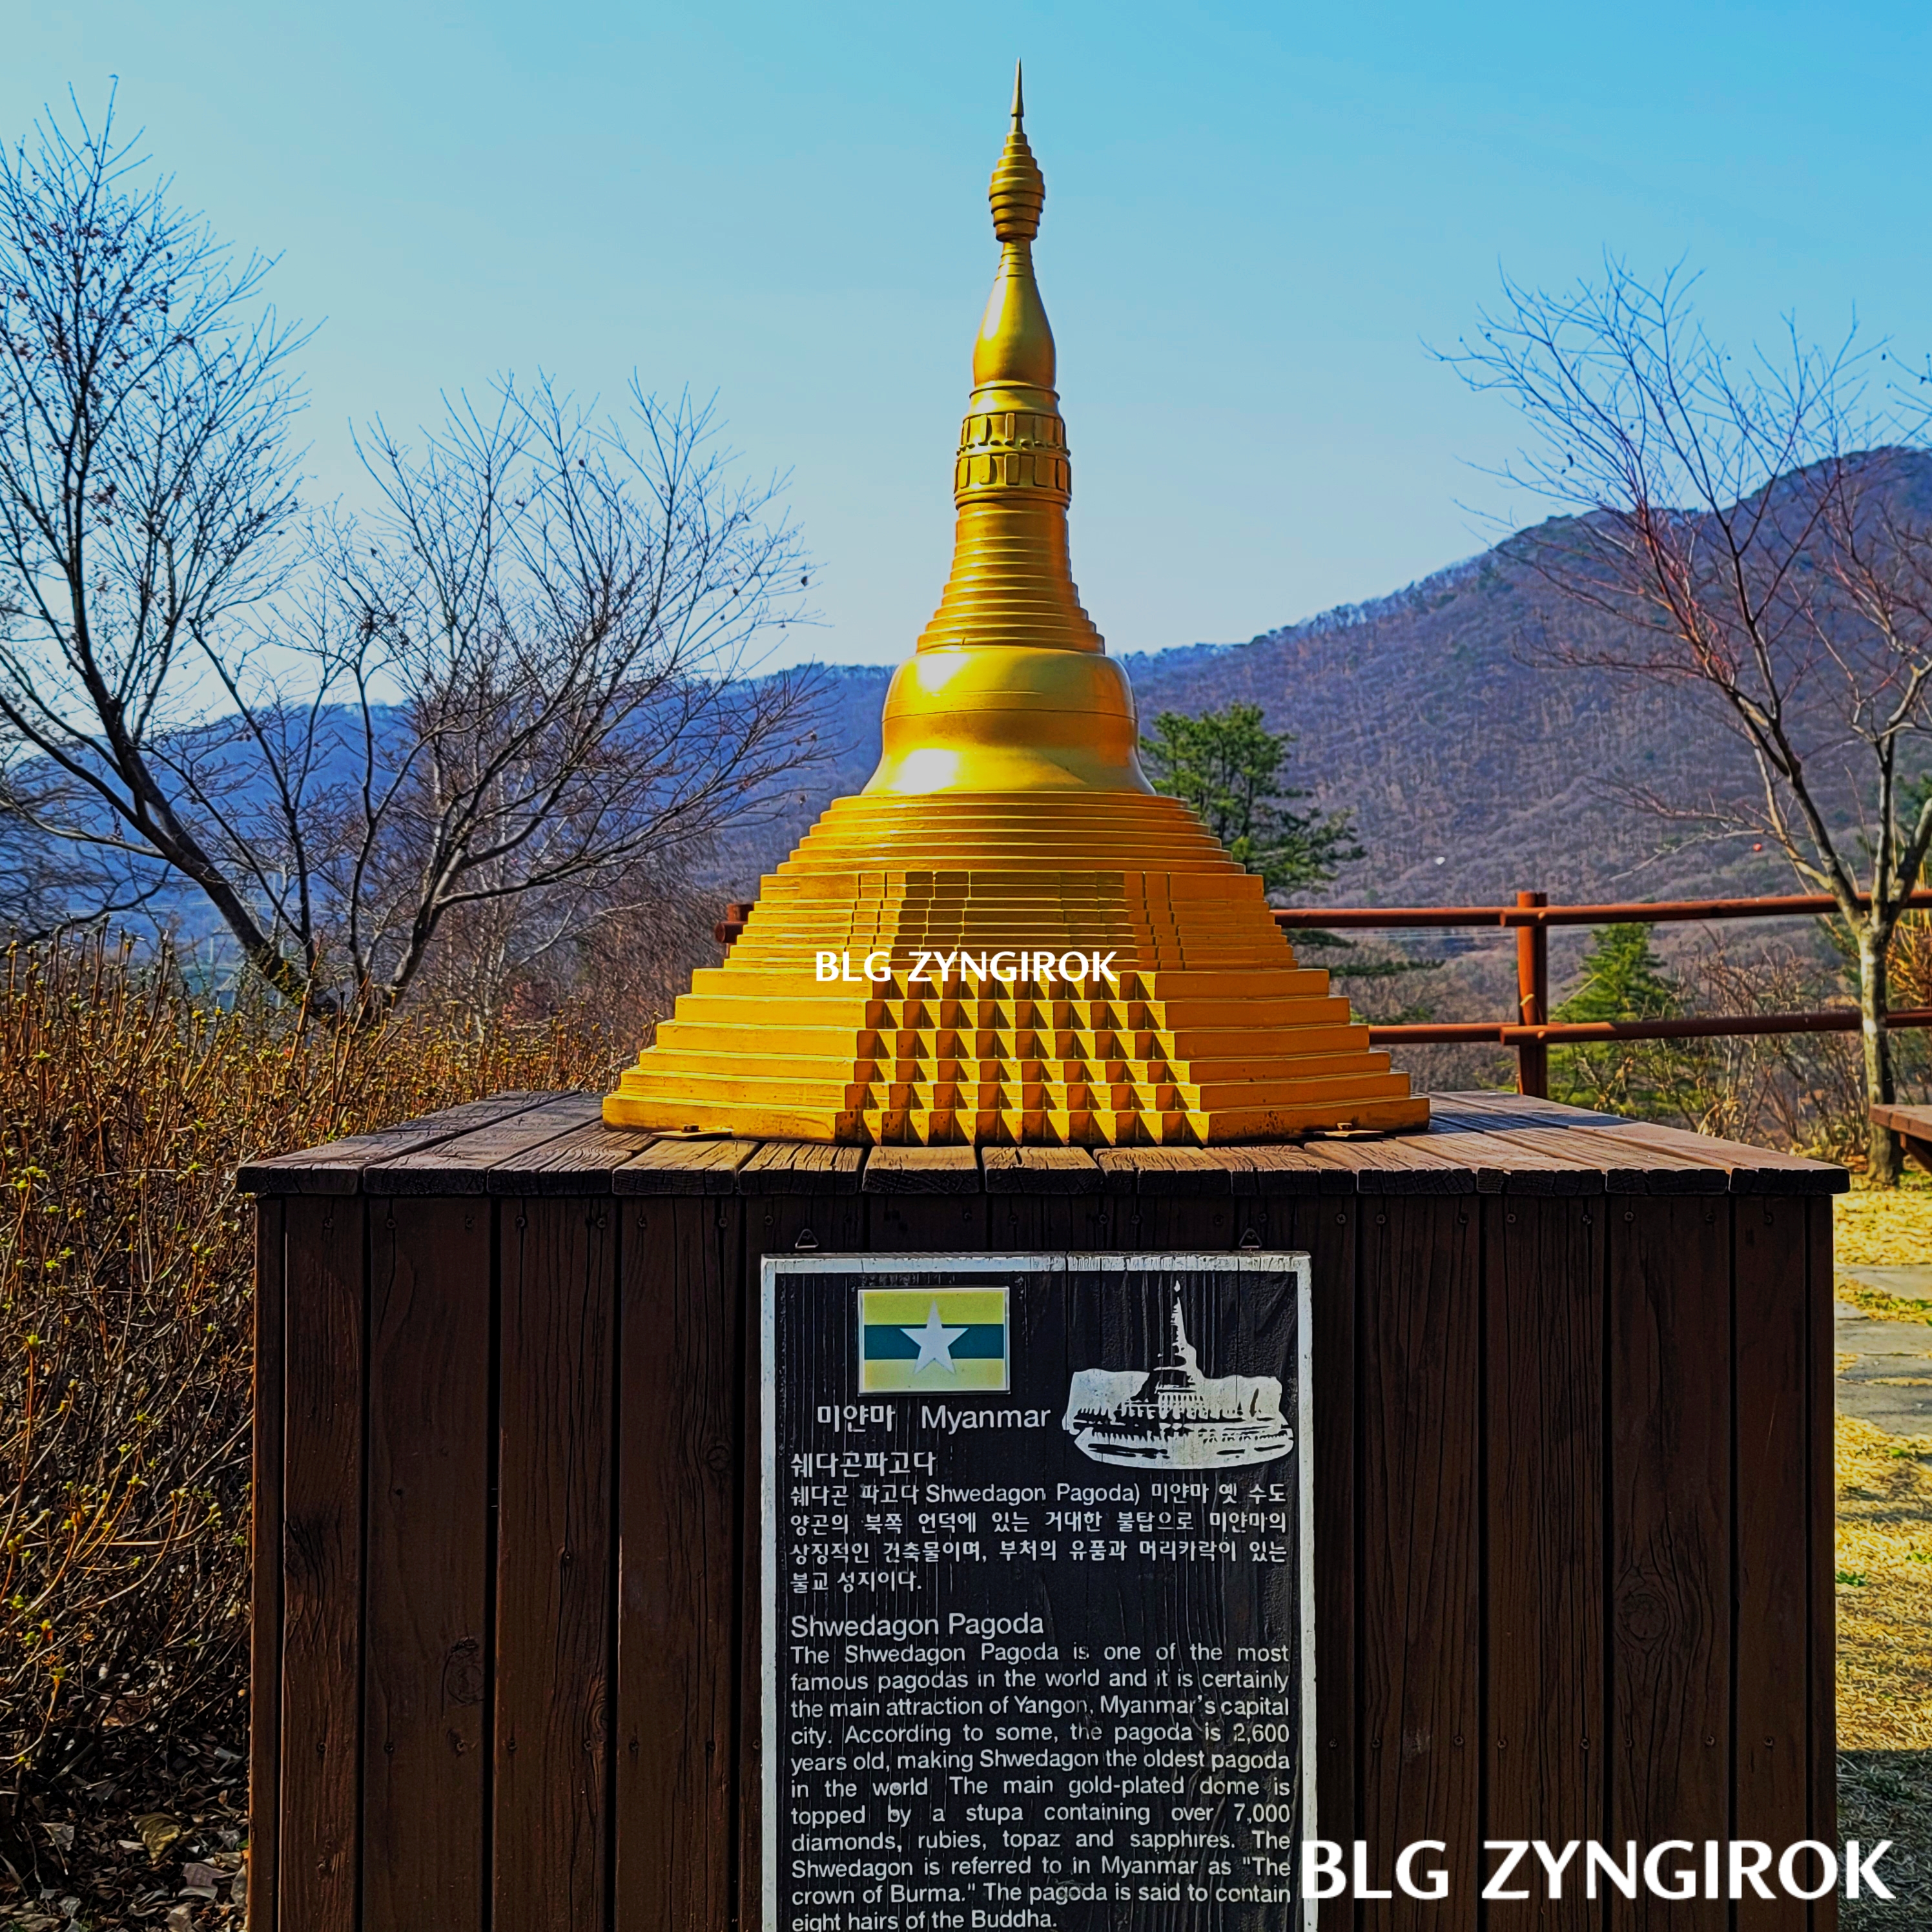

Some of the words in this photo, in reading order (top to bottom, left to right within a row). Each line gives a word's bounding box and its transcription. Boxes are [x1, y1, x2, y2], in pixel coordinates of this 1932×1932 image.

[817, 1404, 895, 1432] 미얀마
[921, 1405, 1051, 1435] Myanmar
[790, 1452, 936, 1477] 쉐다곤파고다
[790, 1486, 848, 1506] 쉐다곤
[860, 1485, 920, 1505] 파고다
[925, 1484, 1045, 1506] Shwedagon
[1057, 1483, 1140, 1505] Pagoda)
[1151, 1483, 1209, 1504] 미얀마
[1249, 1484, 1286, 1505] 수도
[790, 1514, 848, 1536] 양곤의
[864, 1514, 903, 1534] 북쪽
[919, 1512, 976, 1534] 언덕에
[992, 1512, 1029, 1533] 있는
[1045, 1512, 1102, 1532] 거대한
[1117, 1512, 1194, 1532] 불탑으로
[1210, 1512, 1286, 1533] 미얀마의
[790, 1543, 869, 1565] 상징적인
[883, 1541, 987, 1563] 건축물이며,
[1000, 1540, 1056, 1562] 부처의
[1069, 1541, 1127, 1561] 유품과
[1140, 1541, 1236, 1561] 머리카락이
[1249, 1541, 1287, 1563] 있는
[790, 1572, 828, 1594] 불교
[837, 1571, 921, 1593] 성지이다.
[791, 1614, 939, 1641] Shwedagon
[949, 1612, 1043, 1640] Pagoda
[790, 1646, 829, 1664] The
[845, 1645, 965, 1666] Shwedagon
[981, 1642, 1059, 1665] Pagoda
[1073, 1642, 1089, 1660] is
[1104, 1647, 1141, 1660] one
[1156, 1643, 1176, 1660] of
[1190, 1643, 1222, 1661] the
[1237, 1645, 1289, 1662] most
[791, 1673, 868, 1691] famous
[878, 1671, 969, 1693] pagodas
[978, 1670, 994, 1687] in
[1004, 1670, 1036, 1687] the
[1045, 1669, 1099, 1687] world
[1109, 1669, 1147, 1687] and
[1156, 1669, 1168, 1687] it
[1178, 1669, 1193, 1687] is
[1202, 1670, 1289, 1693] certainly
[791, 1700, 823, 1718] the
[830, 1698, 879, 1717] main
[887, 1697, 983, 1715] attraction
[989, 1696, 1009, 1715] of
[1014, 1696, 1094, 1718] Yangon,
[1221, 1696, 1290, 1718] capital
[791, 1726, 832, 1748] city.
[845, 1724, 951, 1746] According
[963, 1724, 983, 1742] to
[996, 1726, 1058, 1743] some,
[1071, 1723, 1102, 1740] the
[1115, 1723, 1193, 1744] pagoda
[1205, 1723, 1221, 1741] is
[1233, 1723, 1290, 1744] 2,600
[791, 1751, 847, 1774] years
[853, 1749, 890, 1774] old,
[898, 1748, 973, 1772] making
[980, 1748, 1099, 1772] Shwedagon
[1105, 1748, 1137, 1769] the
[1144, 1749, 1205, 1770] oldest
[1212, 1750, 1290, 1773] pagoda
[791, 1780, 808, 1798] in
[825, 1779, 857, 1797] the
[873, 1777, 928, 1796] world
[949, 1776, 988, 1795] The
[1003, 1776, 1053, 1794] main
[1069, 1776, 1184, 1798] gold-plated
[1200, 1776, 1260, 1794] dome
[1274, 1777, 1290, 1795] is
[791, 1805, 865, 1829] topped
[888, 1805, 911, 1827] by
[932, 1808, 945, 1822] a
[966, 1804, 1023, 1825] stupa
[1044, 1802, 1150, 1825] containing
[1171, 1807, 1214, 1822] over
[1234, 1803, 1290, 1824] 7,000
[792, 1832, 902, 1852] diamonds,
[918, 1830, 987, 1851] rubies,
[1003, 1830, 1060, 1851] topaz
[1076, 1829, 1114, 1847] and
[1131, 1829, 1235, 1852] sapphires.
[1251, 1830, 1290, 1849] The
[792, 1859, 913, 1880] Shwedagon
[925, 1858, 940, 1875] is
[951, 1856, 1031, 1875] referred
[1042, 1856, 1062, 1874] to
[1073, 1856, 1090, 1873] in
[1102, 1855, 1198, 1878] Myanmar
[1208, 1860, 1231, 1875] as
[1243, 1856, 1291, 1876] "The
[792, 1890, 854, 1906] crown
[863, 1885, 883, 1904] of
[890, 1883, 975, 1903] Burma."
[983, 1882, 1022, 1901] The
[1030, 1882, 1107, 1905] pagoda
[1115, 1882, 1131, 1901] is
[1138, 1883, 1180, 1901] said
[1189, 1884, 1208, 1902] to
[1216, 1884, 1290, 1903] contain
[792, 1913, 841, 1932] eight
[848, 1911, 899, 1929] hairs
[906, 1910, 926, 1929] of
[932, 1909, 964, 1928] the
[971, 1909, 1057, 1928] Buddha.
